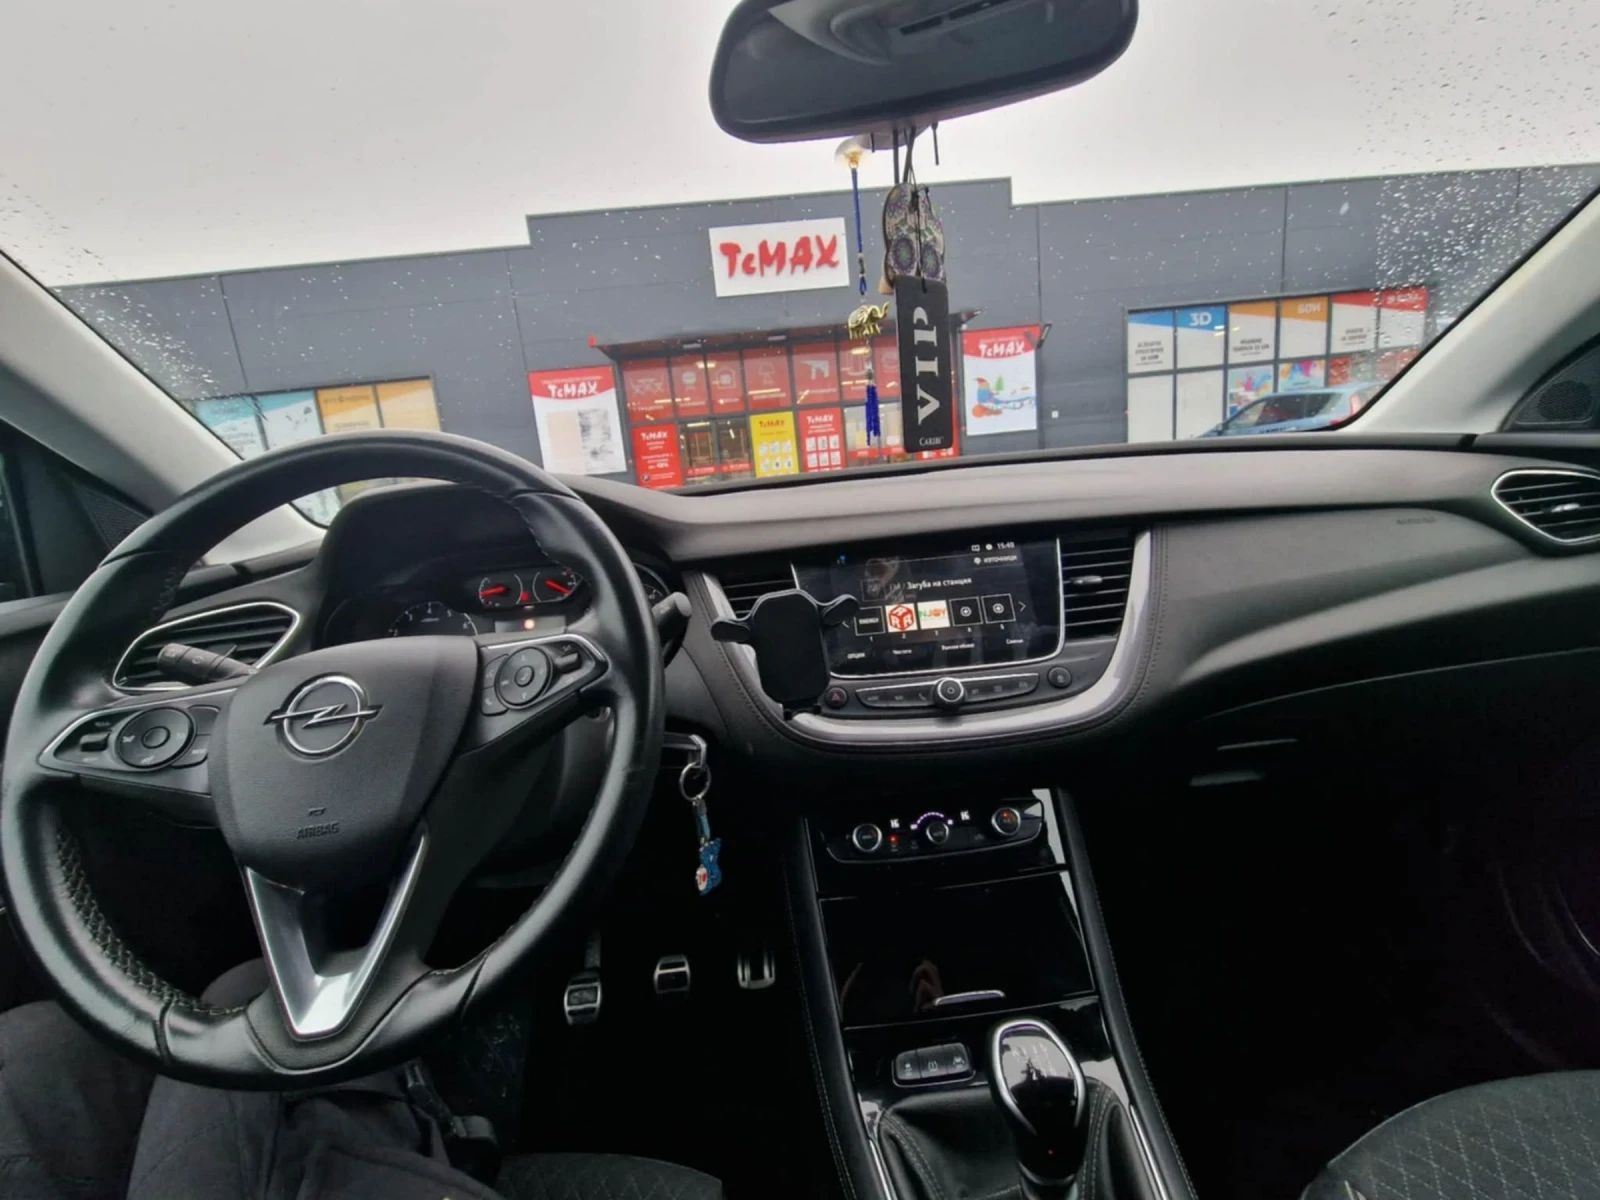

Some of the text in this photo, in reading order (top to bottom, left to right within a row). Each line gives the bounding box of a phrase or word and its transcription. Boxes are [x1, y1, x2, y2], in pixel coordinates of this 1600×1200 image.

[719, 235, 839, 278] TcMAX
[1189, 311, 1212, 326] 3D
[978, 340, 1025, 357] TcMAX
[913, 306, 940, 425] VIP
[547, 380, 598, 399] TcMAX
[907, 581, 931, 590] Загуба
[297, 822, 339, 839] AIRBAG
